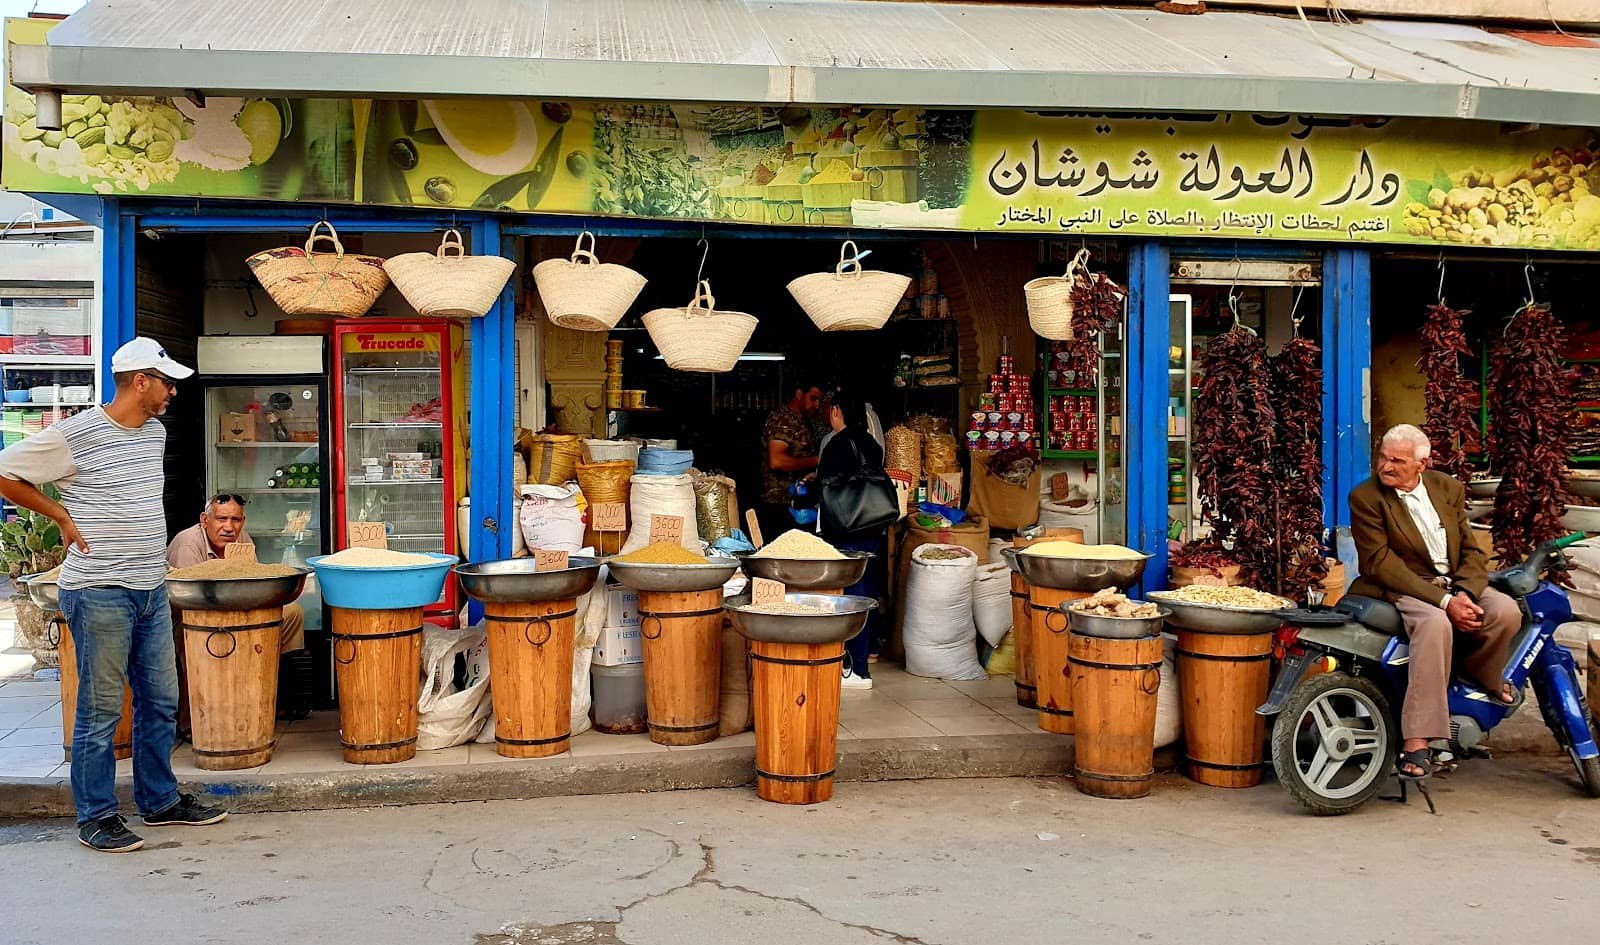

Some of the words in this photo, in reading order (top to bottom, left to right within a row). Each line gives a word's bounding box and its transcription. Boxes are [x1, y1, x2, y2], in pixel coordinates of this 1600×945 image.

[988, 138, 1160, 197] شوشان
[1179, 144, 1313, 201] العولة
[1320, 148, 1400, 206] دار
[997, 206, 1051, 226] المختار
[1059, 207, 1101, 232] النبي
[1109, 208, 1139, 229] على
[1147, 209, 1204, 231] بالصلاة
[1211, 211, 1273, 234] الإنتظار
[1281, 215, 1341, 231] لحظات
[1348, 217, 1390, 239] اغتنم
